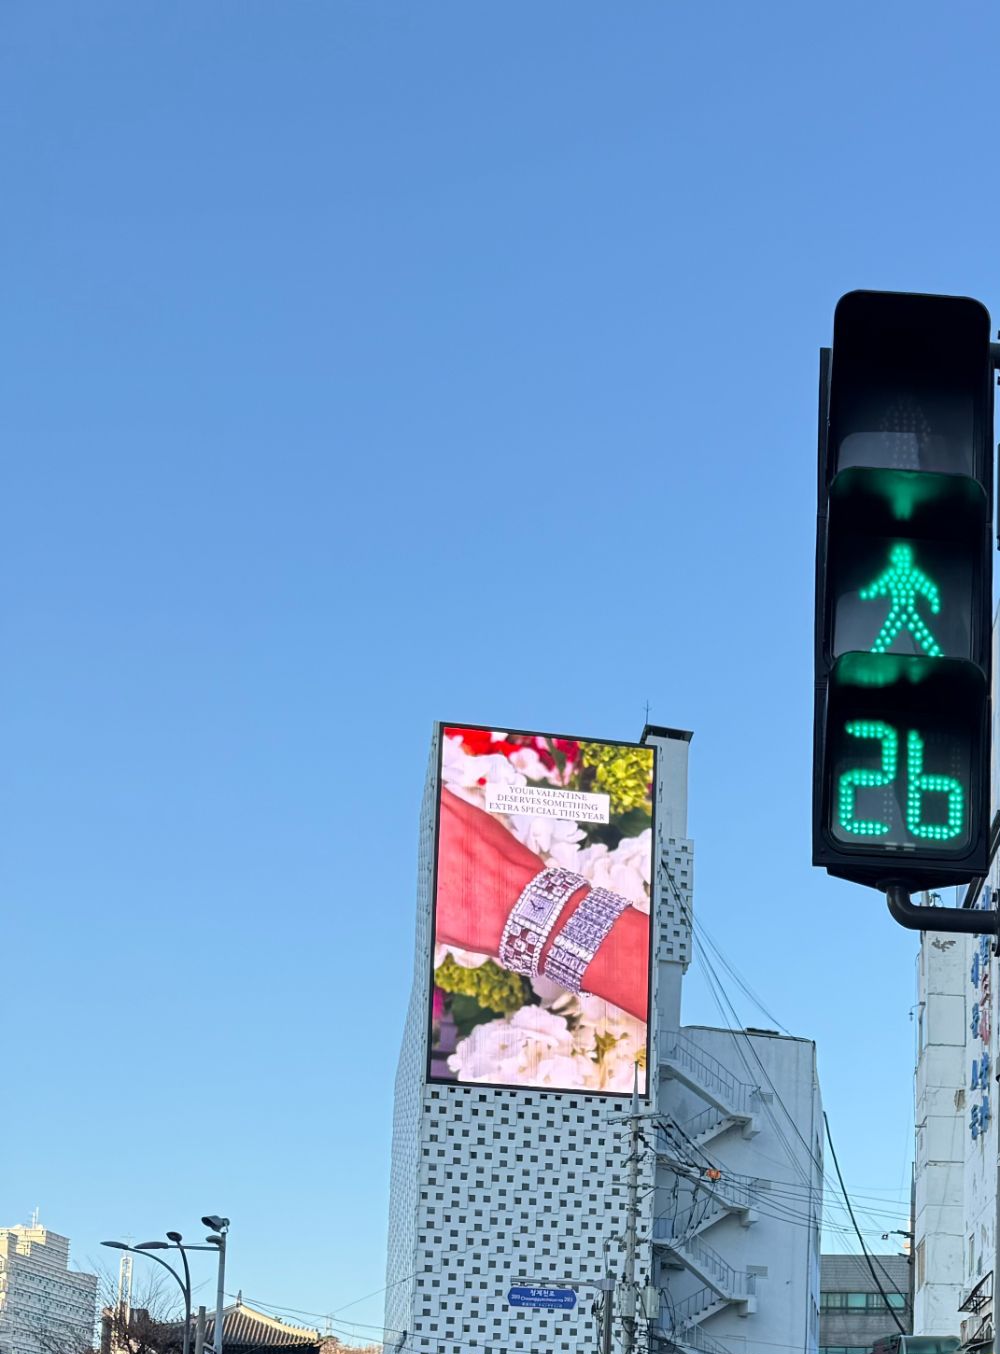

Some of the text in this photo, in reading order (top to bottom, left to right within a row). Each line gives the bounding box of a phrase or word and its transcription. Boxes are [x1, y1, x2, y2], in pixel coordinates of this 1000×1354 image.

[839, 719, 963, 841] 26
[497, 794, 599, 811] DESERVES SOMETHING
[509, 786, 588, 801] YOUR VALENTINE
[489, 802, 605, 821] EXTRA SPECIAL THIS YEAR
